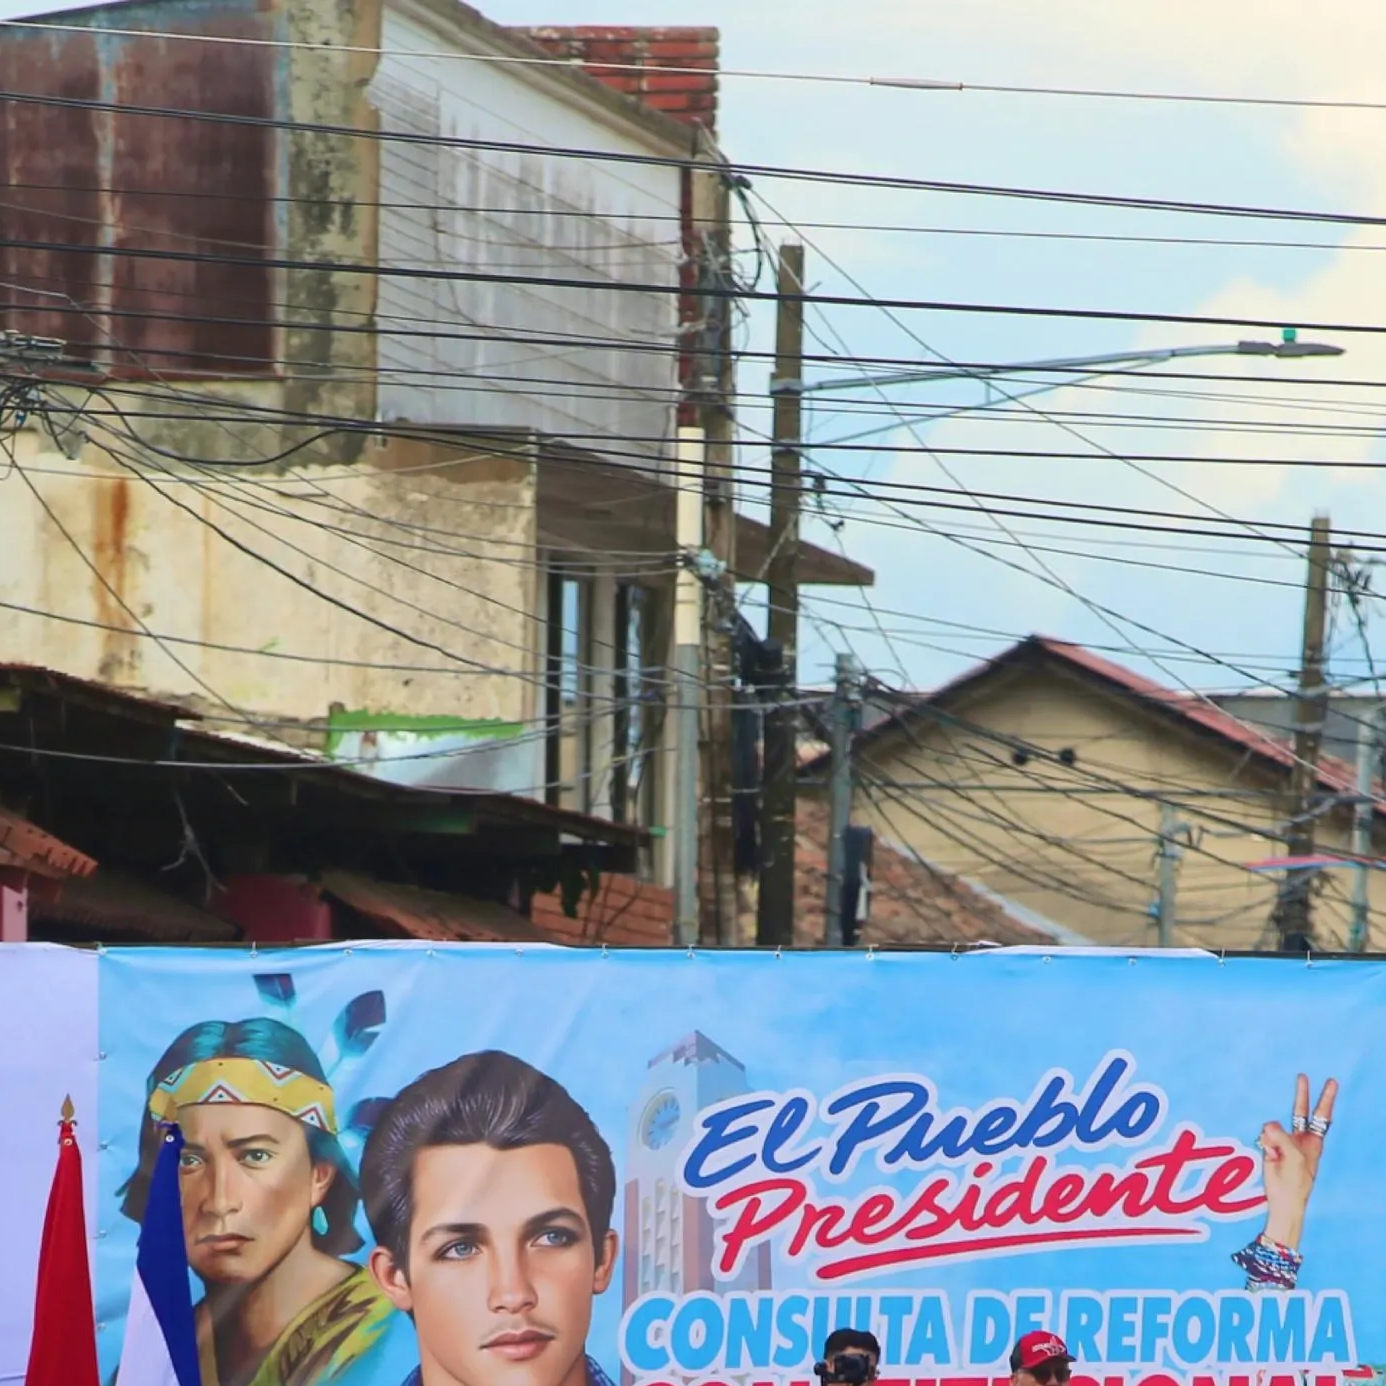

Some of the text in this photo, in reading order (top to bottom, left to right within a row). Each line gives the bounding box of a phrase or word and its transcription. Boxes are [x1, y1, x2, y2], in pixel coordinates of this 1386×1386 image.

[683, 1057, 1161, 1188] El Pueblo
[716, 1129, 1269, 1273] Presidente
[1065, 1295, 1349, 1365] REFORMA
